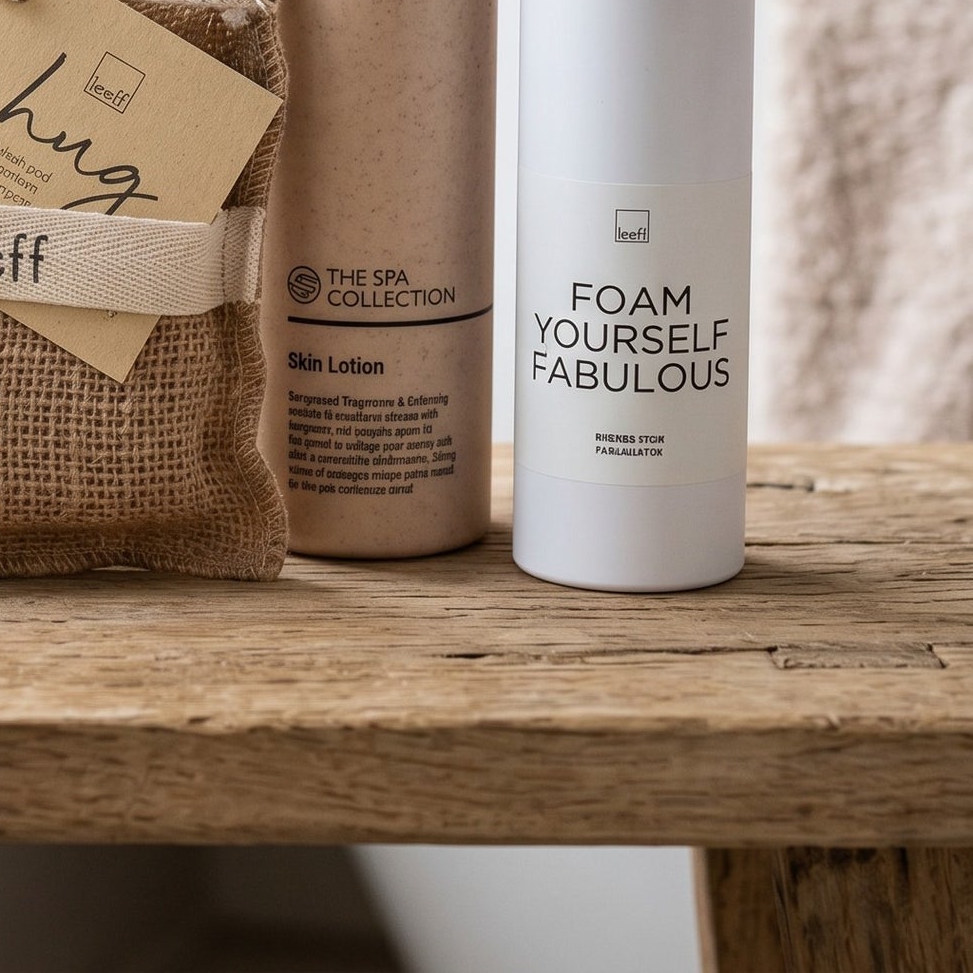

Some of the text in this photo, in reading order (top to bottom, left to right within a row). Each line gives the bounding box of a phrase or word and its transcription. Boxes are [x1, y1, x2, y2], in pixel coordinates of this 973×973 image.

[326, 268, 409, 287] THE SPA
[327, 286, 456, 308] COLLECTION
[572, 282, 691, 316] FOAM
[534, 312, 730, 354] YOURSELF
[288, 352, 384, 375] Skin Lotion
[533, 350, 730, 393] FABULOUS
[398, 397, 405, 407] &
